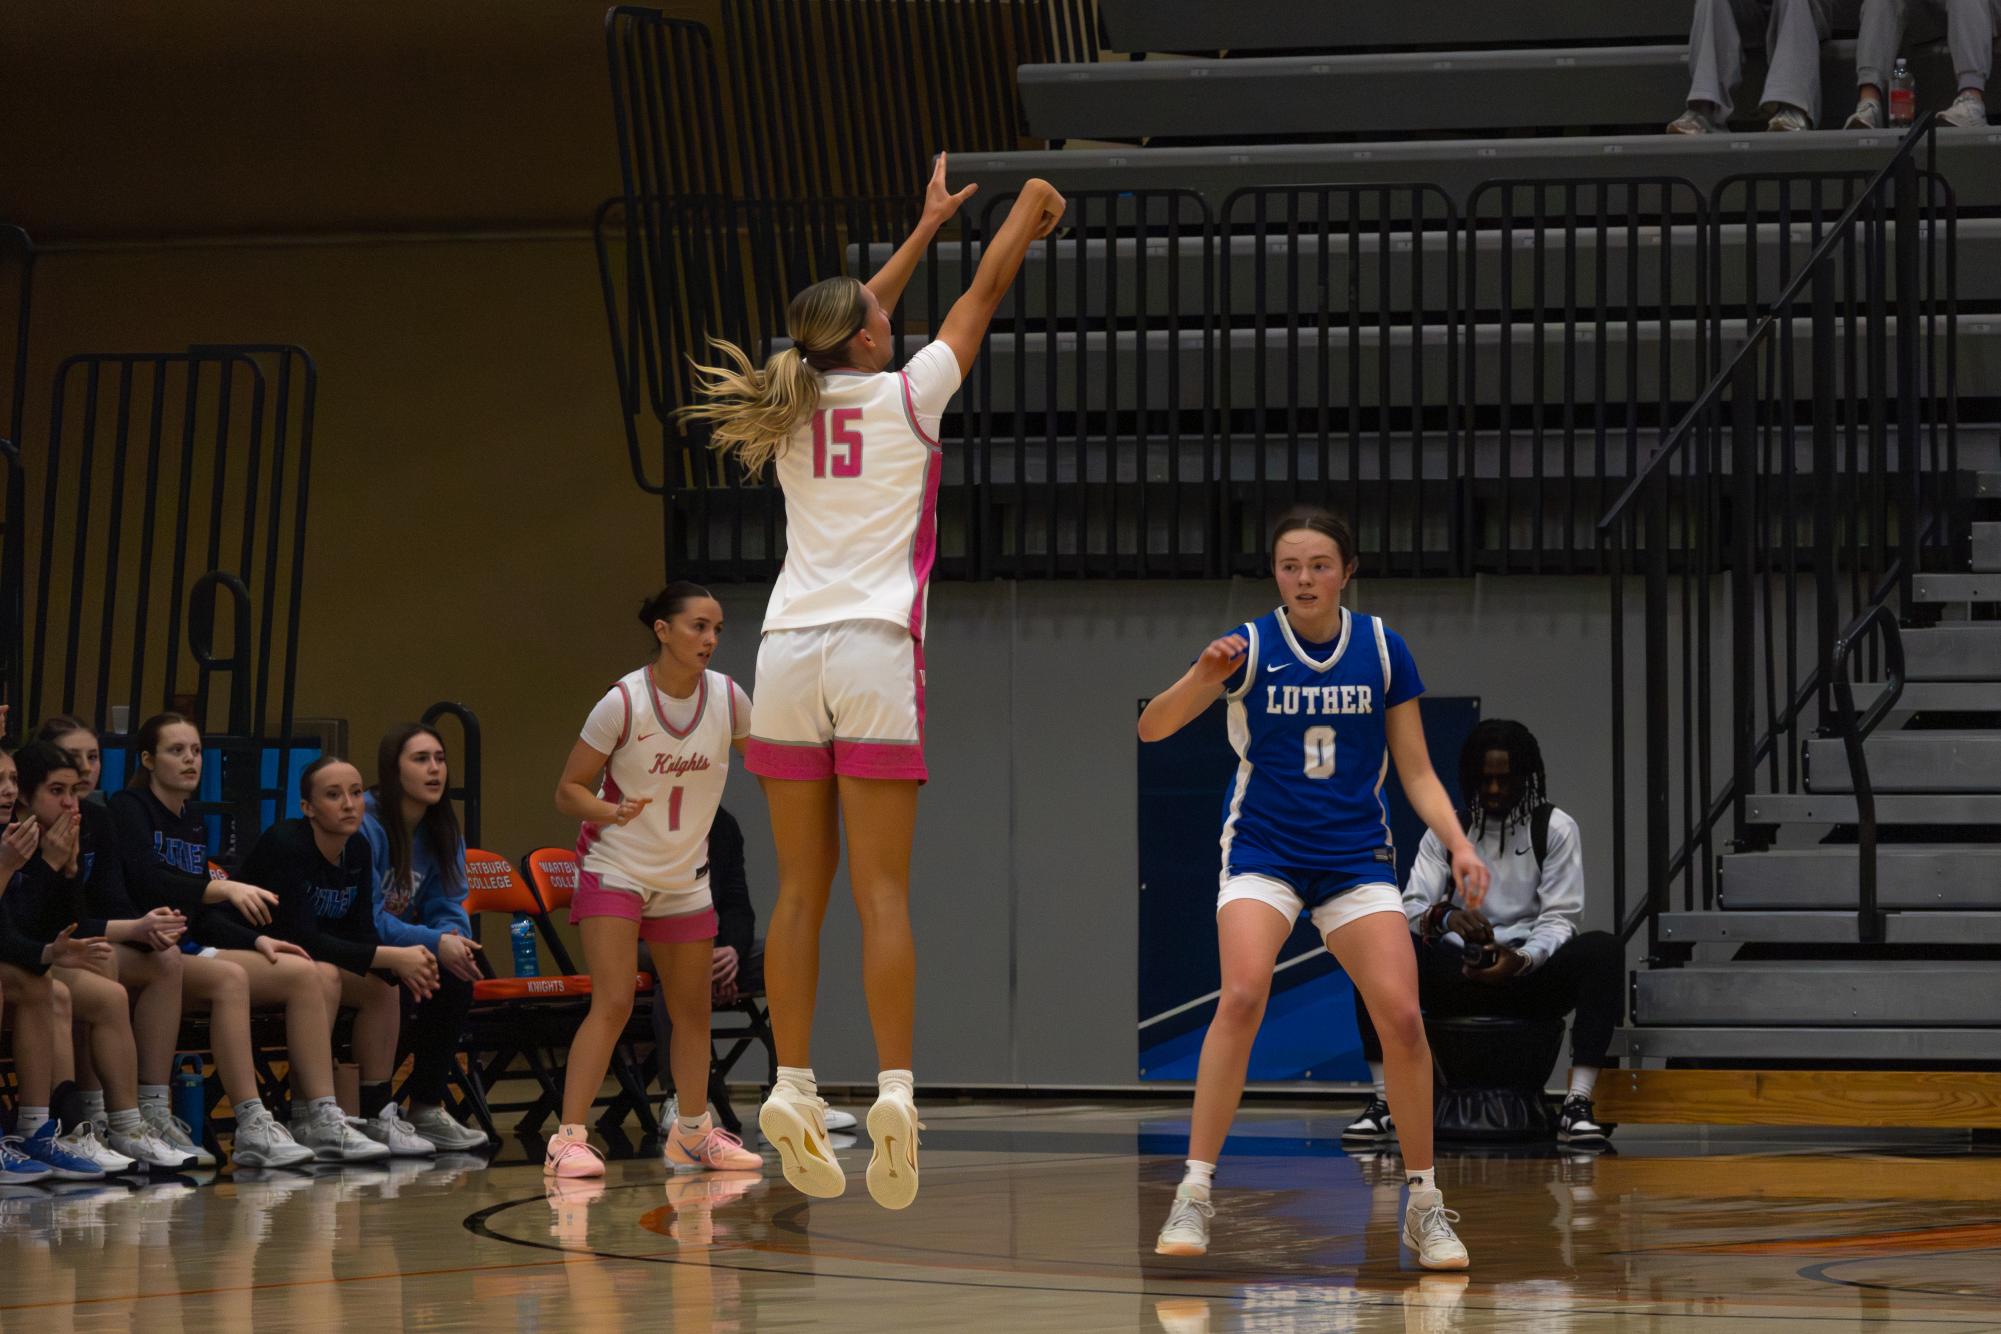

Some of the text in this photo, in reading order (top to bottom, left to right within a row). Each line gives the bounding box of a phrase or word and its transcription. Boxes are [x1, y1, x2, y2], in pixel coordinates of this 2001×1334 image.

[811, 407, 864, 479] 15
[1266, 685, 1373, 716] LUTHER
[648, 752, 711, 777] Knights
[1303, 725, 1336, 779] 0
[668, 786, 685, 832] 1
[465, 861, 512, 875] ARTBURG
[539, 861, 576, 873] WARTBU
[528, 980, 565, 992] KNIGHTS
